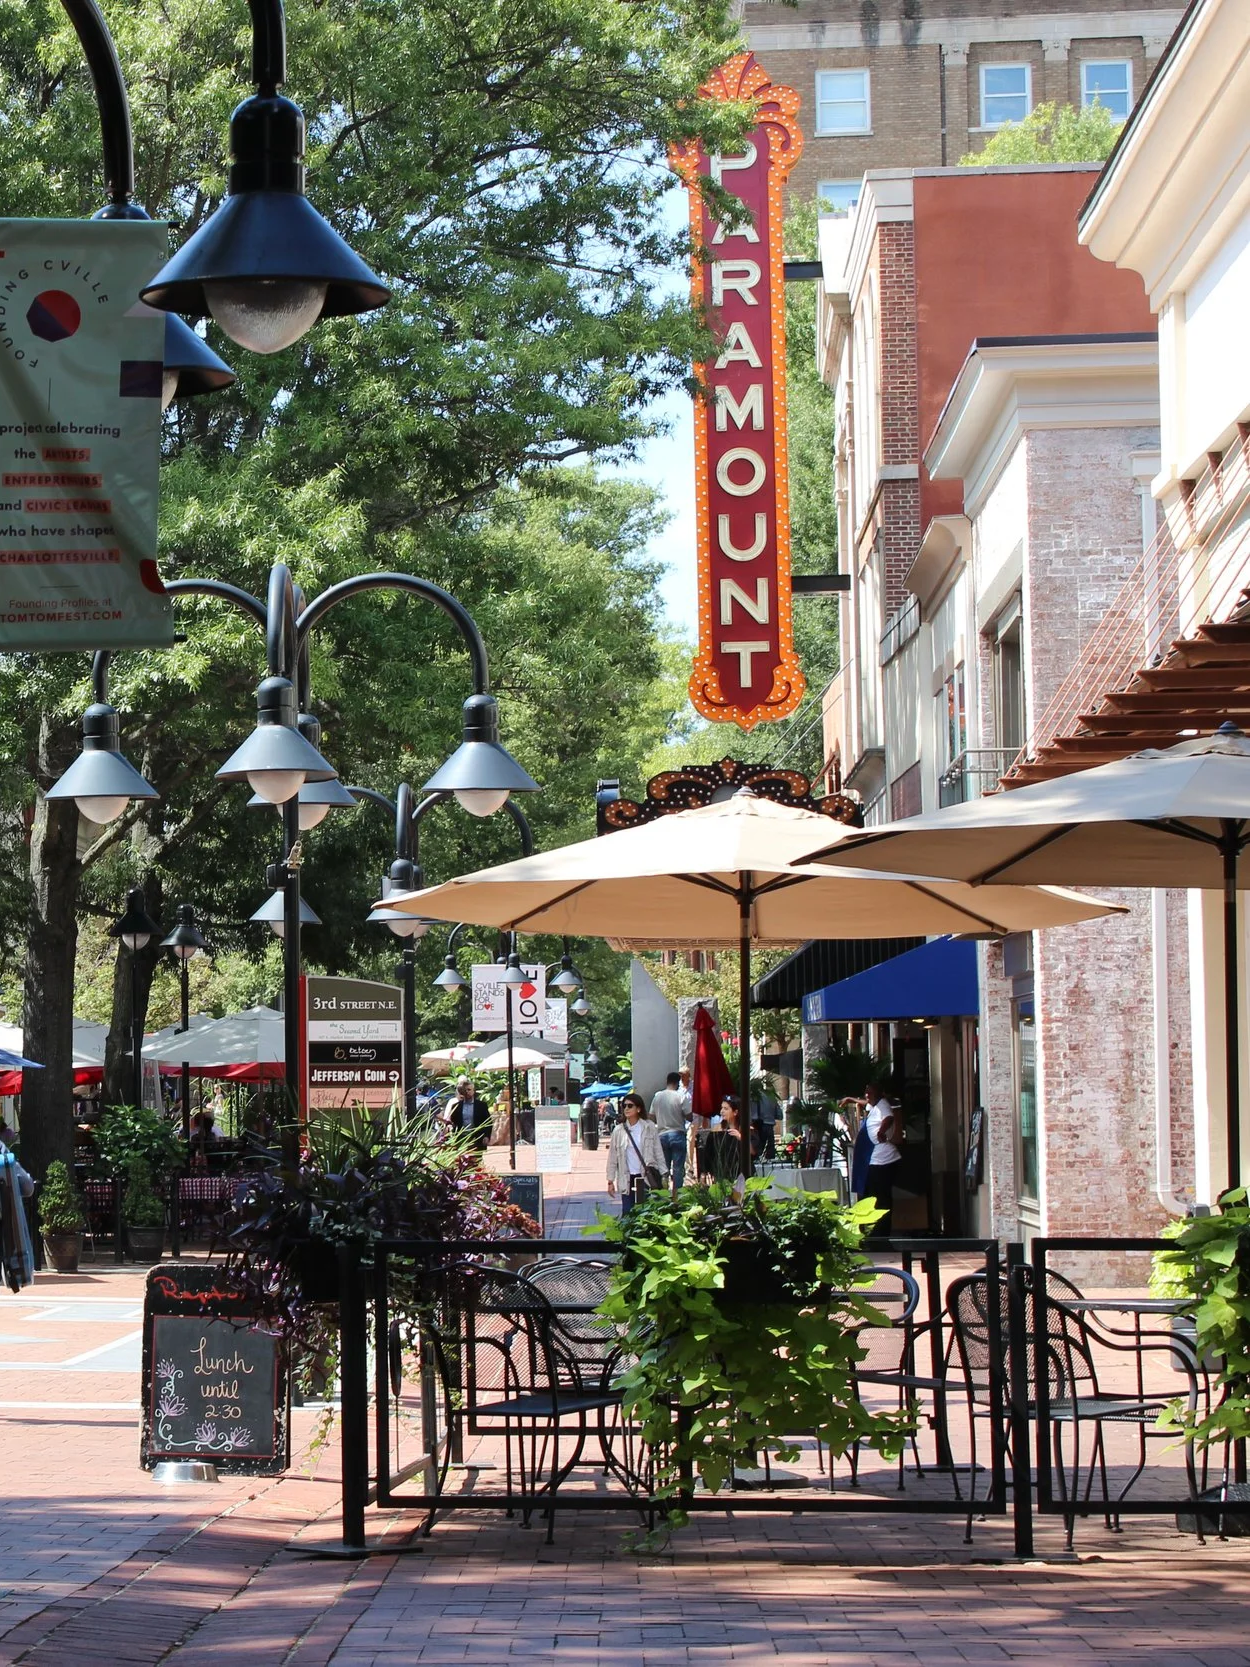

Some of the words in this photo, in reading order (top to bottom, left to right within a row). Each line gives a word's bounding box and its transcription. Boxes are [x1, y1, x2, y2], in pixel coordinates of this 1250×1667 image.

[44, 260, 109, 304] CVILLE
[45, 422, 121, 438] celebrating
[14, 447, 37, 459] the
[26, 499, 61, 511] CIVIC
[31, 525, 65, 537] have
[9, 599, 58, 611] Founding
[61, 598, 99, 609] Profiles
[102, 598, 112, 607] at
[0, 610, 122, 624] TOMTOMFEST.COM
[475, 982, 501, 990] CVILLE
[474, 989, 504, 997] STANDS
[313, 996, 337, 1010] 3rd
[340, 1001, 377, 1010] STREET
[378, 1001, 397, 1010] N.E.
[475, 996, 491, 1004] FOR
[311, 1069, 361, 1082] JEFFERSON
[364, 1069, 386, 1082] COIN
[190, 1336, 254, 1375] Lunch
[200, 1379, 240, 1400] until
[204, 1404, 242, 1420] 2:30
